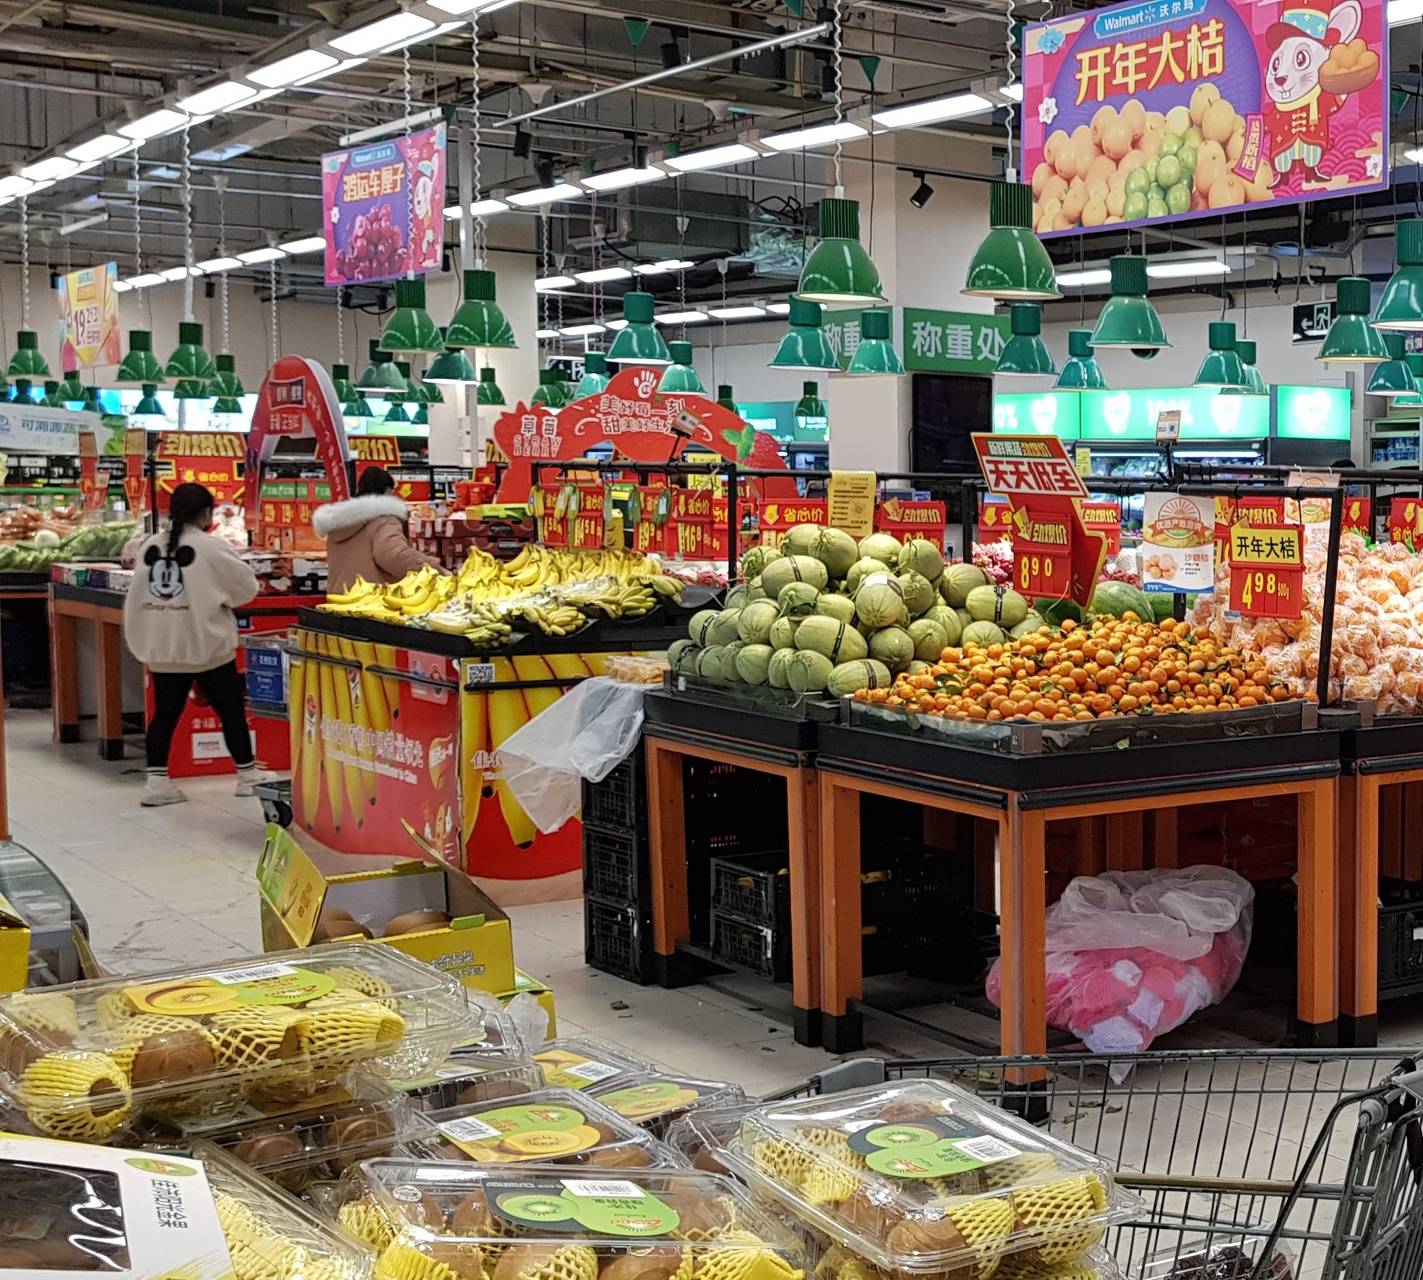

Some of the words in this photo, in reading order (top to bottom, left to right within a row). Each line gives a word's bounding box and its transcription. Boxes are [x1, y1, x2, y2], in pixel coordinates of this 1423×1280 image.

[1104, 13, 1144, 31] Walmart
[1159, 1, 1194, 18] 沃尔玛
[1075, 19, 1225, 106] 开年大桔
[342, 162, 405, 202] 鸿运车厘子
[911, 320, 1007, 363] 称重处
[513, 435, 563, 448] STRAW
[520, 415, 558, 437] 草莓
[513, 444, 559, 457] BERRY
[986, 460, 1080, 492] 天天低至
[1236, 536, 1295, 560] 开年大桔
[1020, 556, 1052, 590] 890
[1242, 572, 1276, 609] 498
